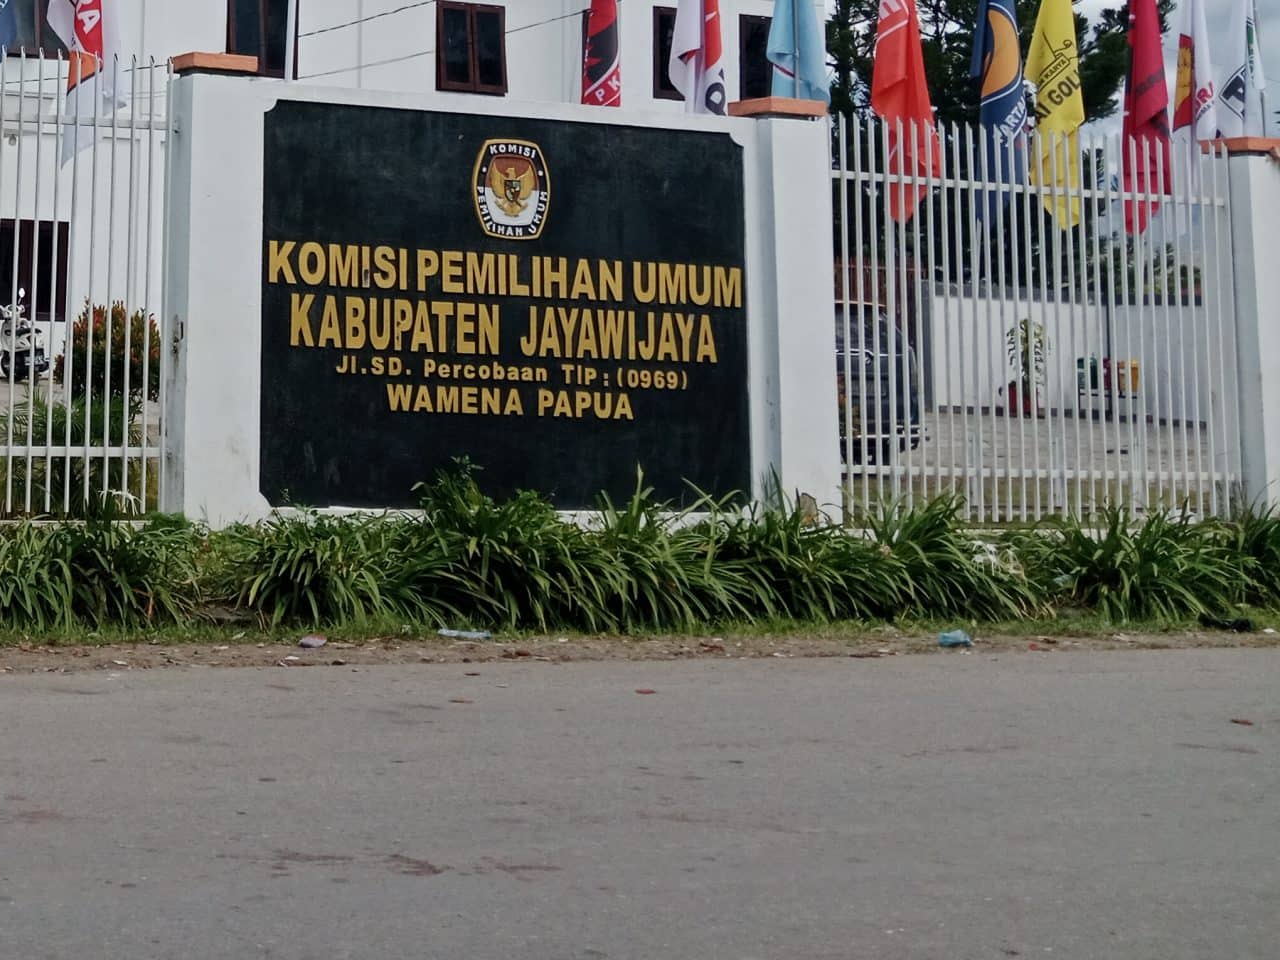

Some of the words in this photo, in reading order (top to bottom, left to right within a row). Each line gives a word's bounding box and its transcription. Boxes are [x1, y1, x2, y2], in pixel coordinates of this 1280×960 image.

[1044, 59, 1067, 79] KARYA
[1048, 69, 1081, 106] GOL
[489, 144, 536, 159] KOMISI
[477, 186, 523, 236] PEMILIHAN
[528, 191, 548, 234] UMUM
[269, 240, 408, 290] KOMISI
[417, 249, 624, 302] PEMILIHAN
[632, 261, 742, 308] UMUM
[290, 293, 500, 355] KABUPATEN
[520, 305, 718, 363] JAYAWIJAYA
[424, 359, 548, 382] Percobaan
[617, 367, 688, 390] (0969)
[386, 383, 524, 416] WAMENA
[538, 388, 634, 420] PAPUA
